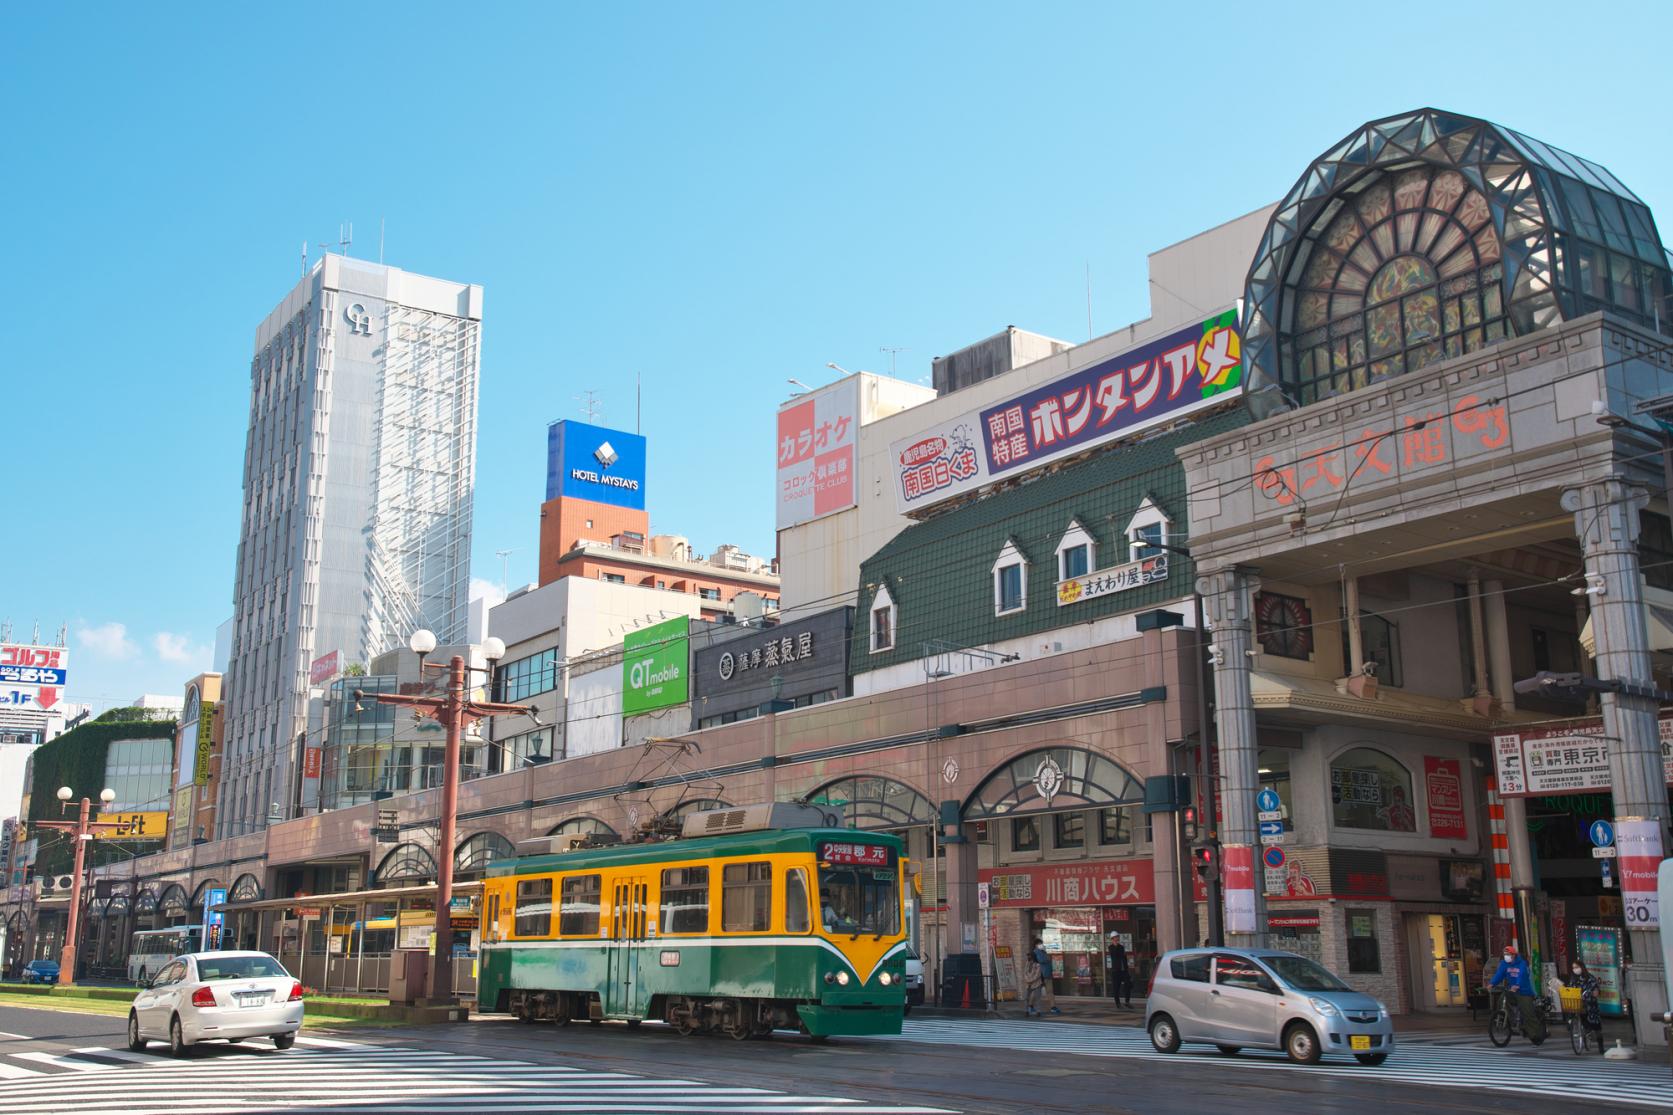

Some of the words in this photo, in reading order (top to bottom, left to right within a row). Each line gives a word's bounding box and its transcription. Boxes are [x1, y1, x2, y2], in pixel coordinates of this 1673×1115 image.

[1029, 325, 1241, 449] ボンタンアメ
[779, 415, 852, 463] カラオケ
[988, 404, 1025, 441] 南国
[991, 433, 1029, 466] 特産
[1302, 410, 1446, 491] 天文館
[571, 468, 599, 483] HOTEL
[600, 474, 639, 490] MYSTAYS
[902, 449, 977, 499] 南国白くま
[1085, 567, 1140, 596] まえわり屋
[824, 844, 833, 860] 2
[1045, 875, 1139, 902] 川商ハウス
